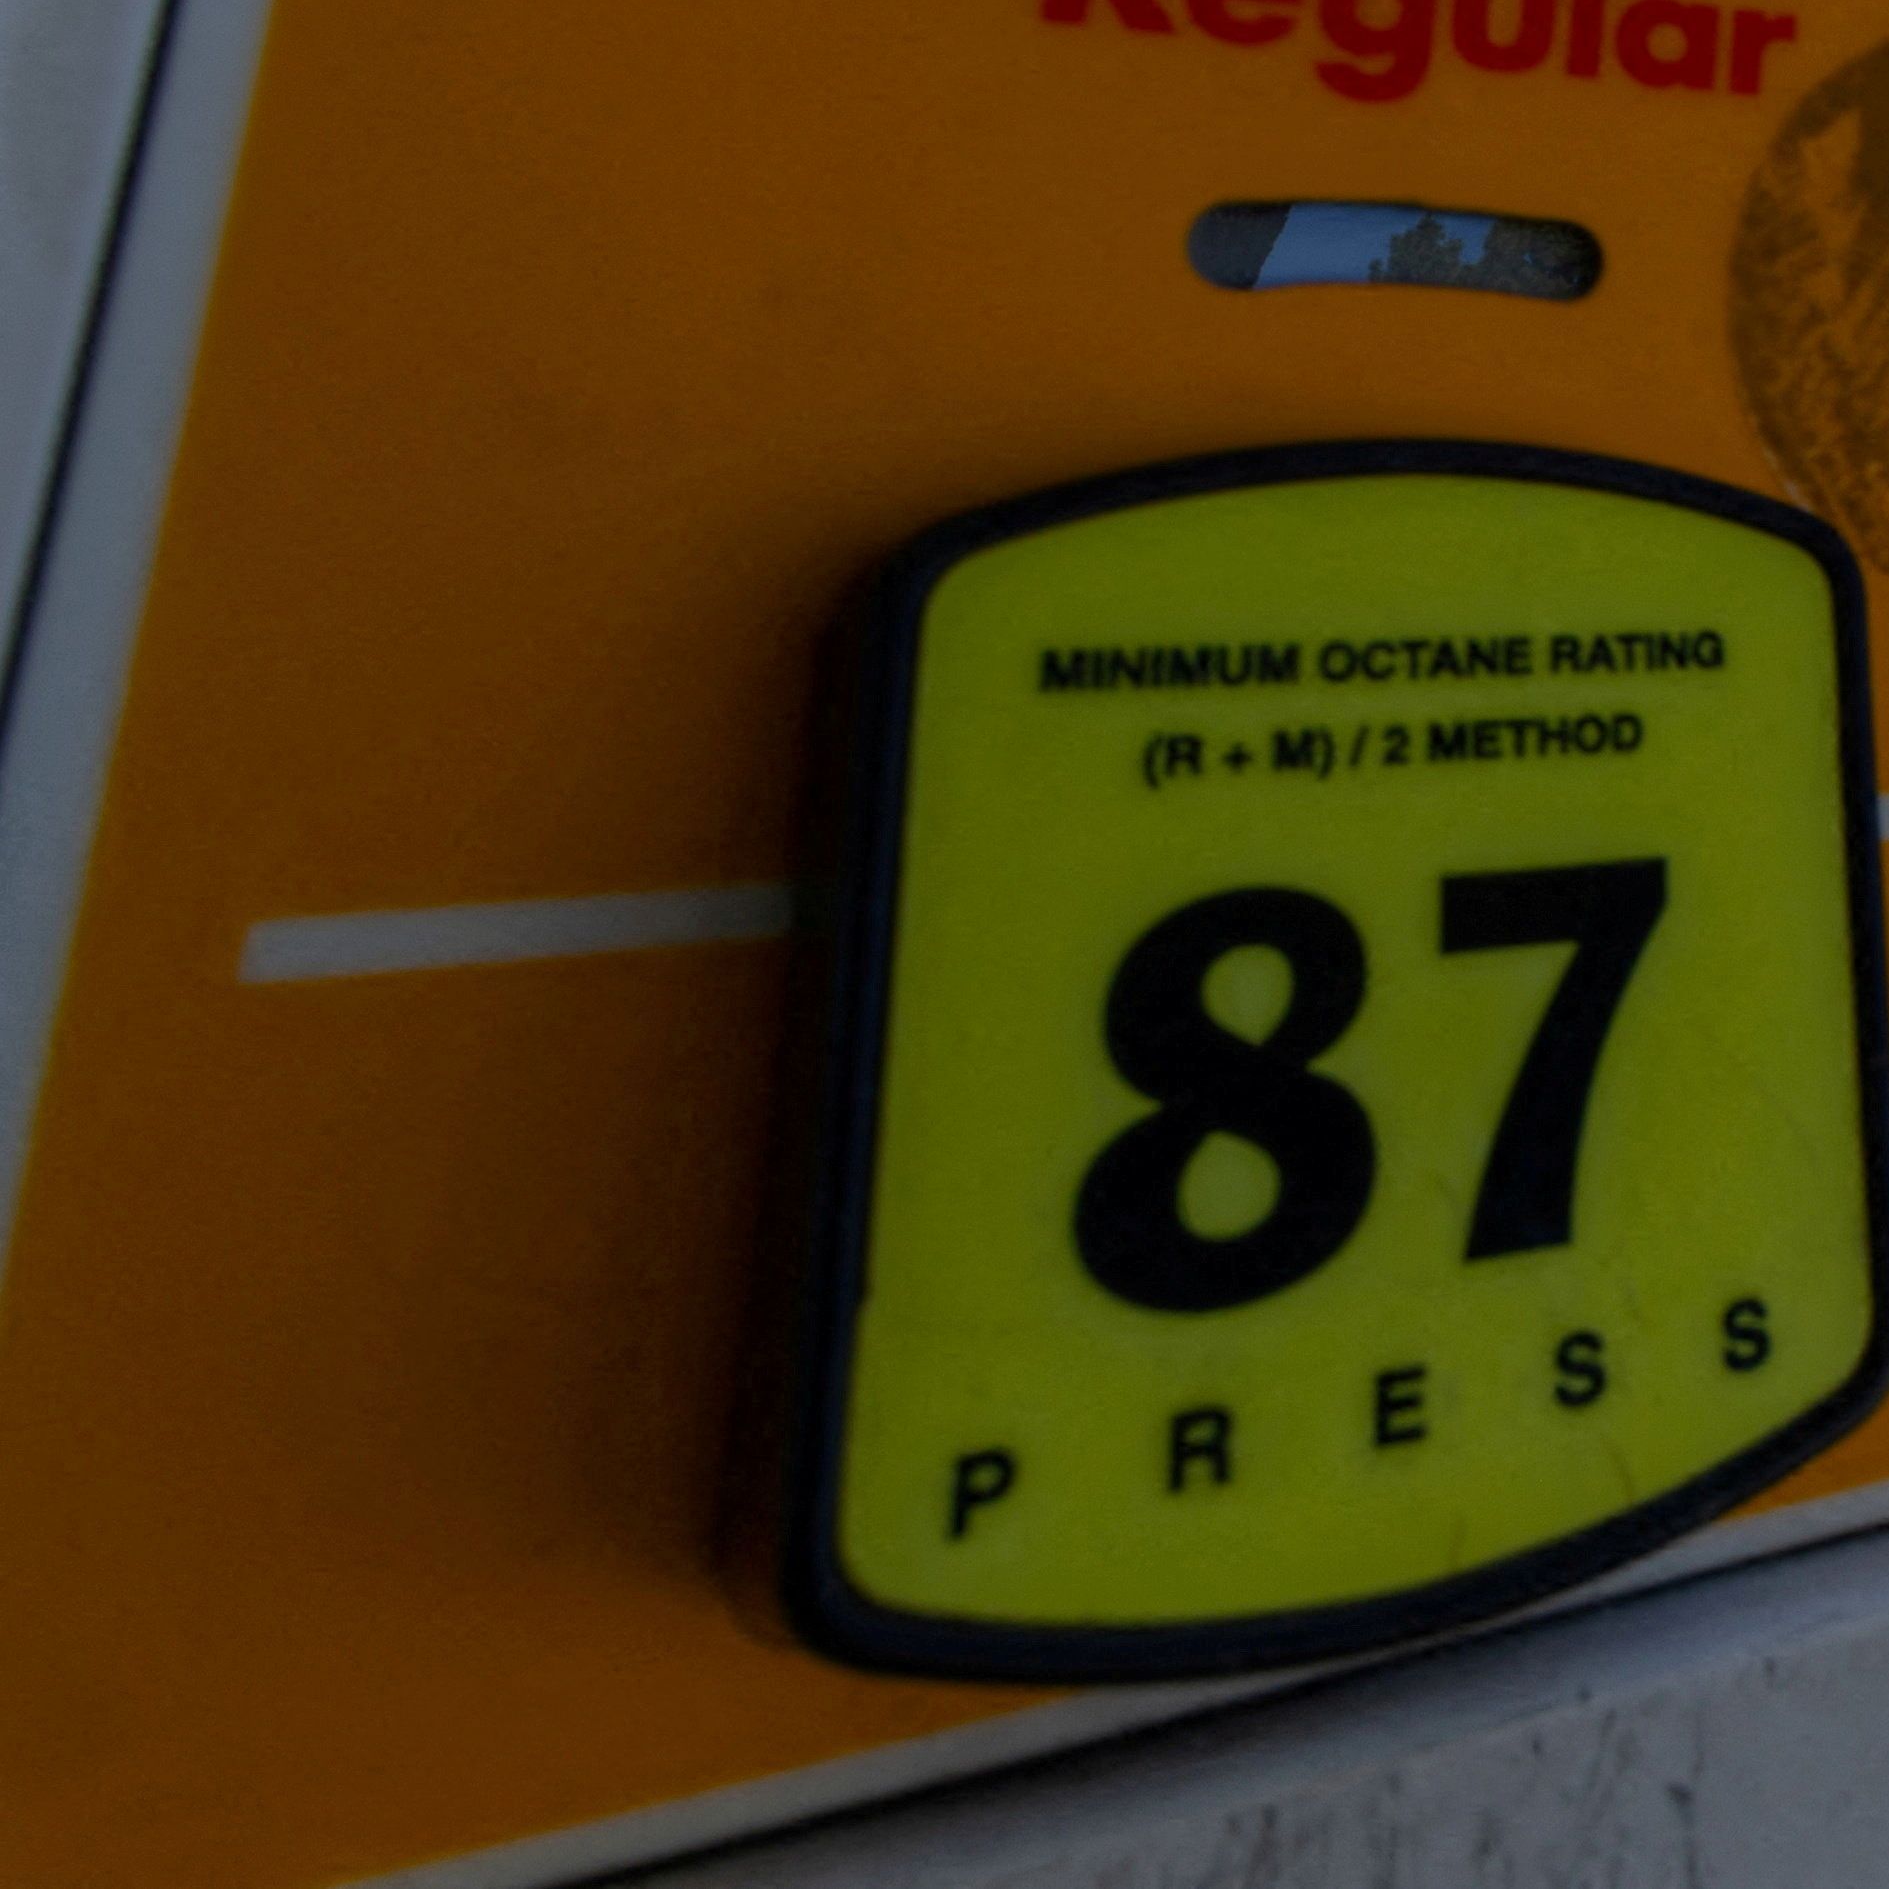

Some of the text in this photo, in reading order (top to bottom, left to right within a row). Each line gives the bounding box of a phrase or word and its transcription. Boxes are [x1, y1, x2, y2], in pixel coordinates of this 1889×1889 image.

[1040, 630, 1726, 692] MINIMUM OCTANE RATING
[1427, 713, 1645, 760] METHOD
[1074, 855, 1669, 1315] 87
